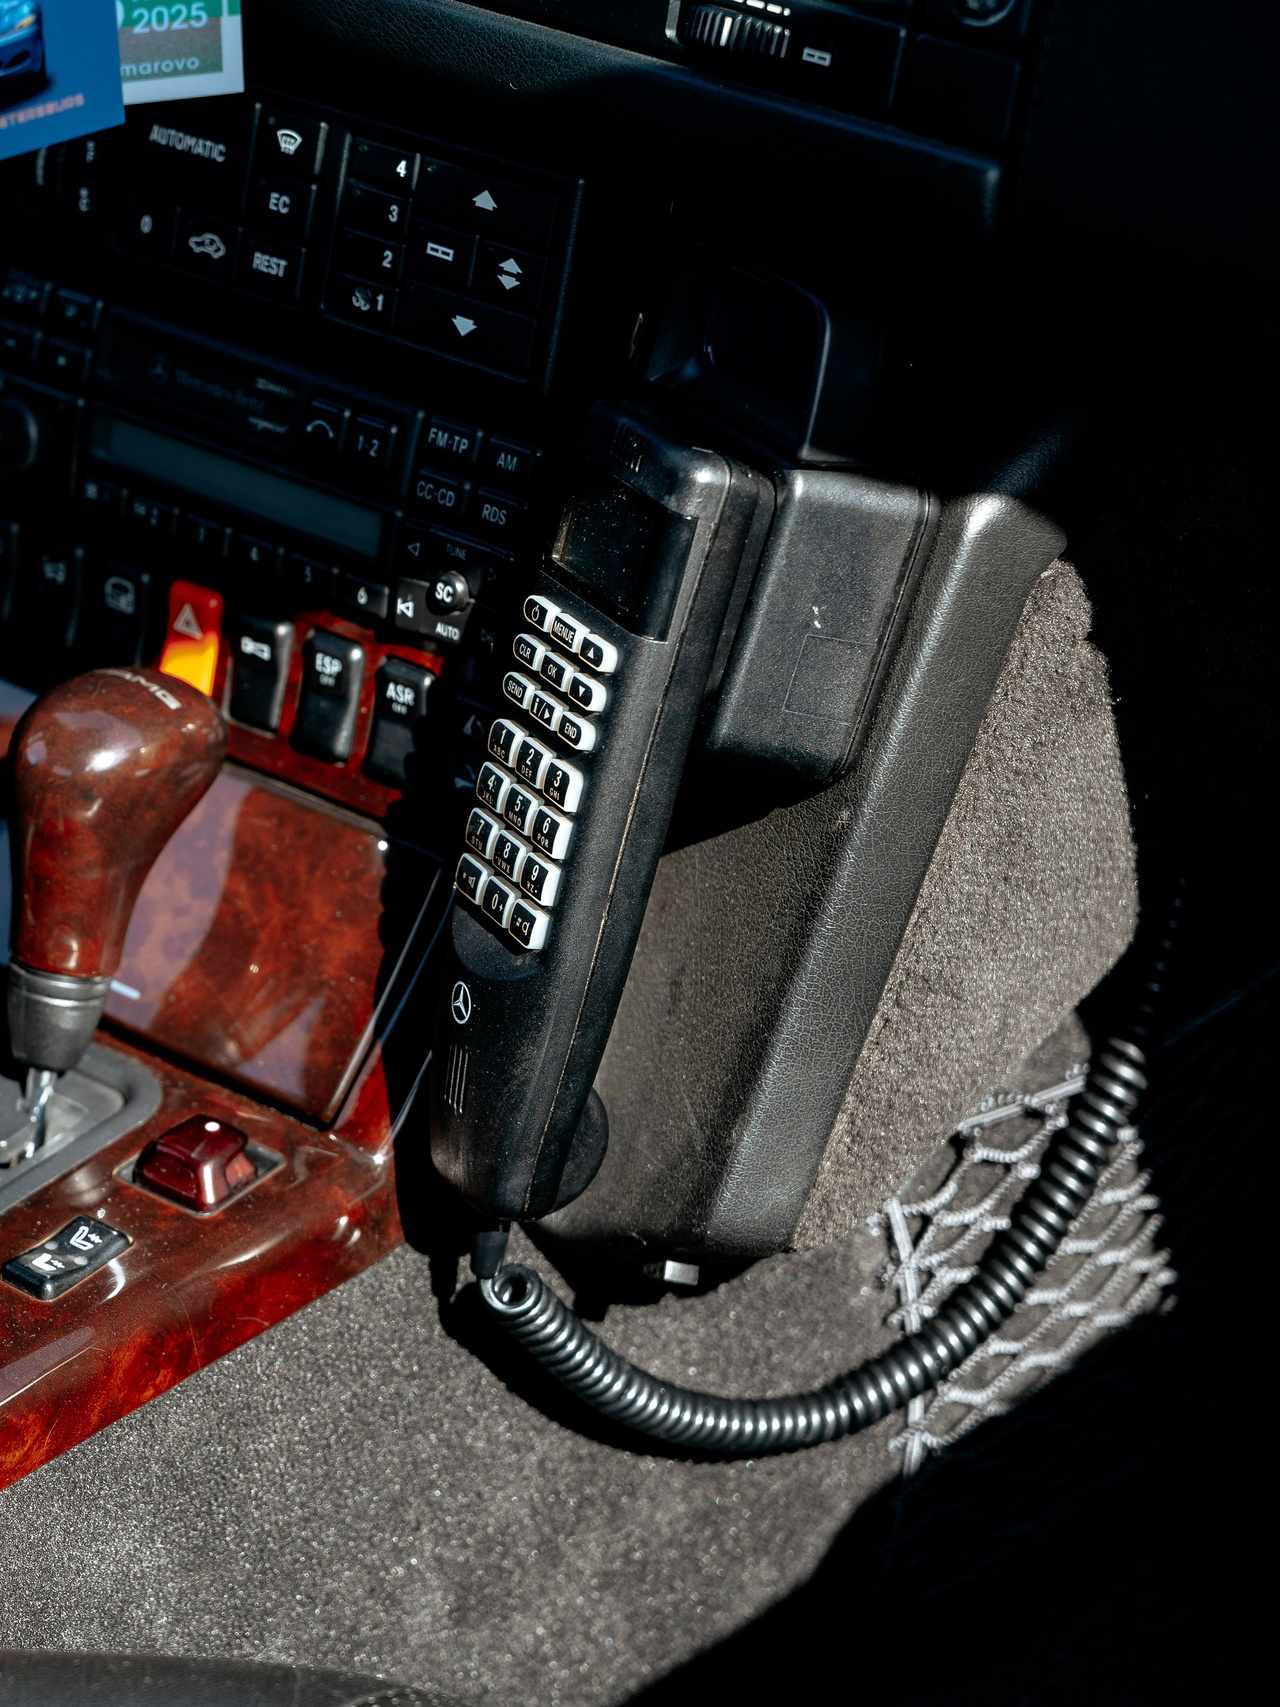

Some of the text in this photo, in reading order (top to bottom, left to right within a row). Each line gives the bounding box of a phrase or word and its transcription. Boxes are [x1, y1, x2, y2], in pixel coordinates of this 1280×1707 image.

[131, 1, 208, 35] 2025
[148, 123, 227, 163] AUTOMATIC
[395, 159, 408, 178] 4
[268, 191, 291, 214] EC
[388, 204, 400, 223] 3
[139, 213, 153, 235] 0
[252, 251, 289, 278] REST
[381, 249, 394, 269] 2
[376, 293, 385, 312] 1
[496, 452, 518, 473] AM
[481, 503, 508, 526] RDS
[446, 543, 469, 561] TUNE
[356, 586, 369, 606] 6
[434, 582, 454, 604] SC
[435, 621, 461, 642] AUTO
[552, 620, 575, 644] MENUE
[519, 643, 532, 660] CLR
[314, 652, 343, 678] ESP
[547, 664, 558, 679] OK
[385, 681, 416, 707] ASR
[507, 680, 523, 698] SEND
[500, 728, 507, 745] 1
[564, 722, 577, 739] END
[492, 744, 506, 759] ABC
[525, 748, 535, 766] 2
[521, 764, 533, 779] DEF
[553, 770, 562, 787] 3
[487, 774, 496, 791] 4
[482, 790, 493, 805] JKL
[514, 794, 523, 812] 5
[549, 787, 560, 801] GHI
[476, 818, 486, 836] 7
[508, 810, 522, 827] MNO
[542, 817, 552, 834] 6
[471, 835, 483, 851] STU
[536, 833, 549, 849] PQR
[503, 842, 512, 859] 8
[497, 857, 511, 874] VWX
[530, 864, 540, 881] 9
[491, 893, 499, 910] 0
